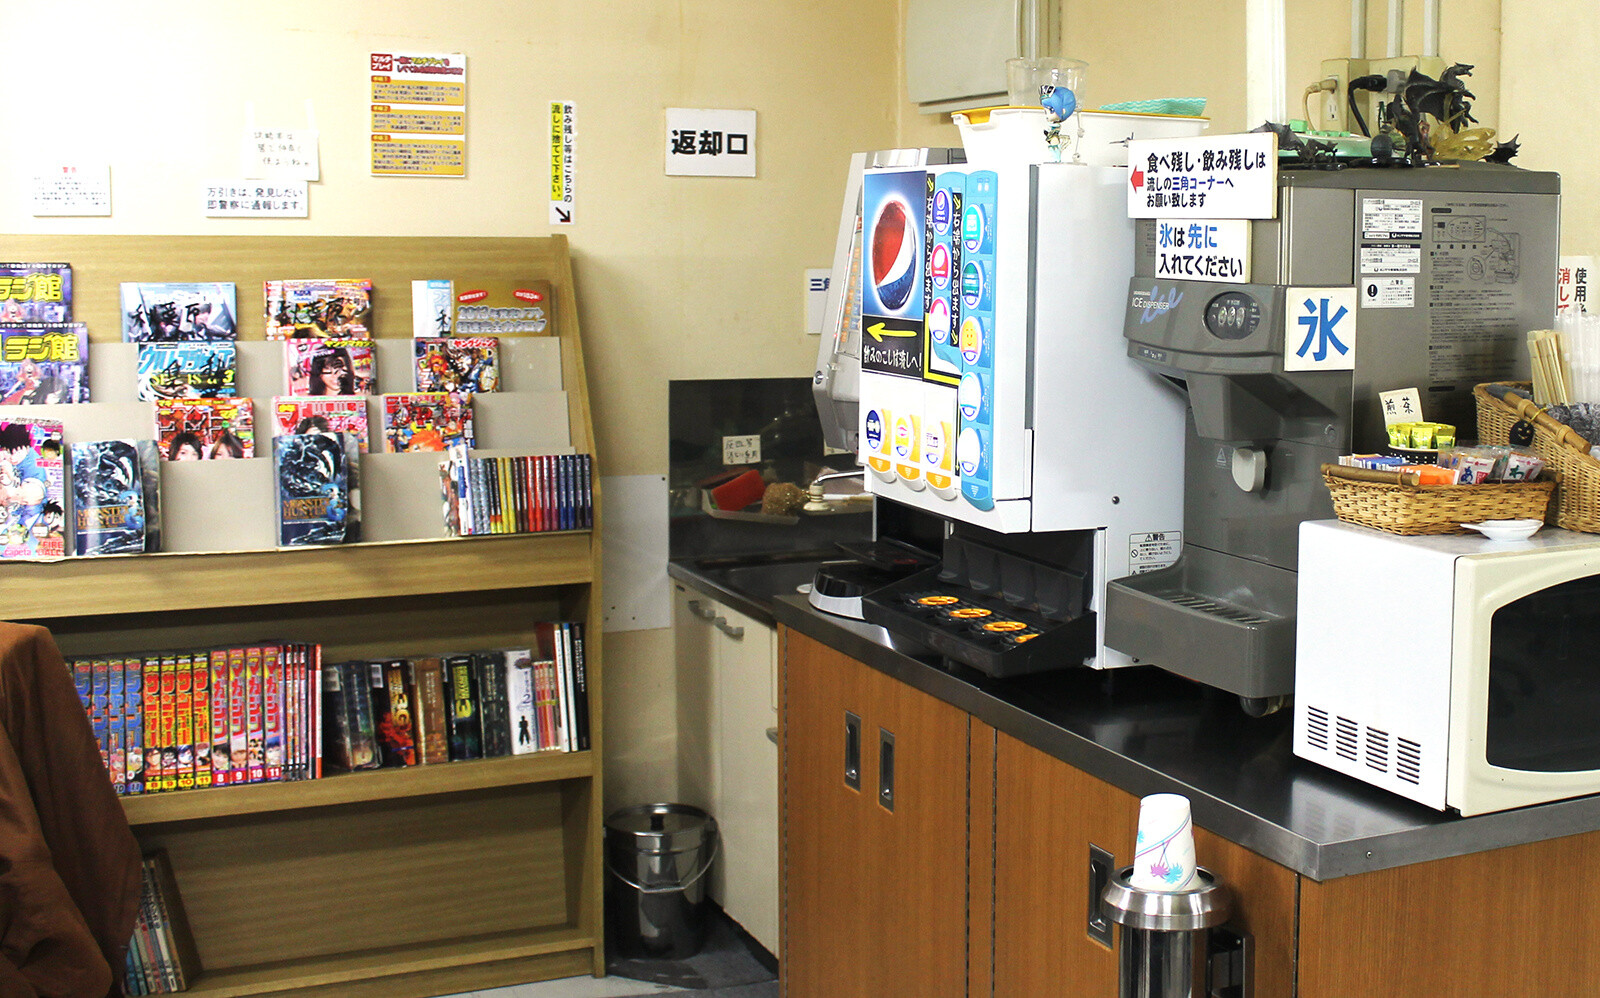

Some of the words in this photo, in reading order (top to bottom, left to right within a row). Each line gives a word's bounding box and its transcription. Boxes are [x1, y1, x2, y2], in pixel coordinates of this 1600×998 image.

[671, 129, 748, 156] 返却口
[563, 104, 573, 203] 飲み残し等はこちらの
[1146, 148, 1267, 174] 食べ残し・飲み残しは
[1146, 174, 1234, 192] 流しの三角コーナーへ
[1146, 192, 1207, 208] お願い致します
[1159, 223, 1218, 249] 氷は先に
[1158, 253, 1244, 278] 入れてください
[1132, 297, 1144, 307] ICE
[1295, 297, 1350, 362] 氷
[283, 498, 330, 508] MONSTER
[1153, 533, 1166, 541] 警告
[217, 773, 224, 782] 8
[235, 771, 243, 780] 9
[252, 769, 263, 778] 10
[269, 768, 280, 776] 11
